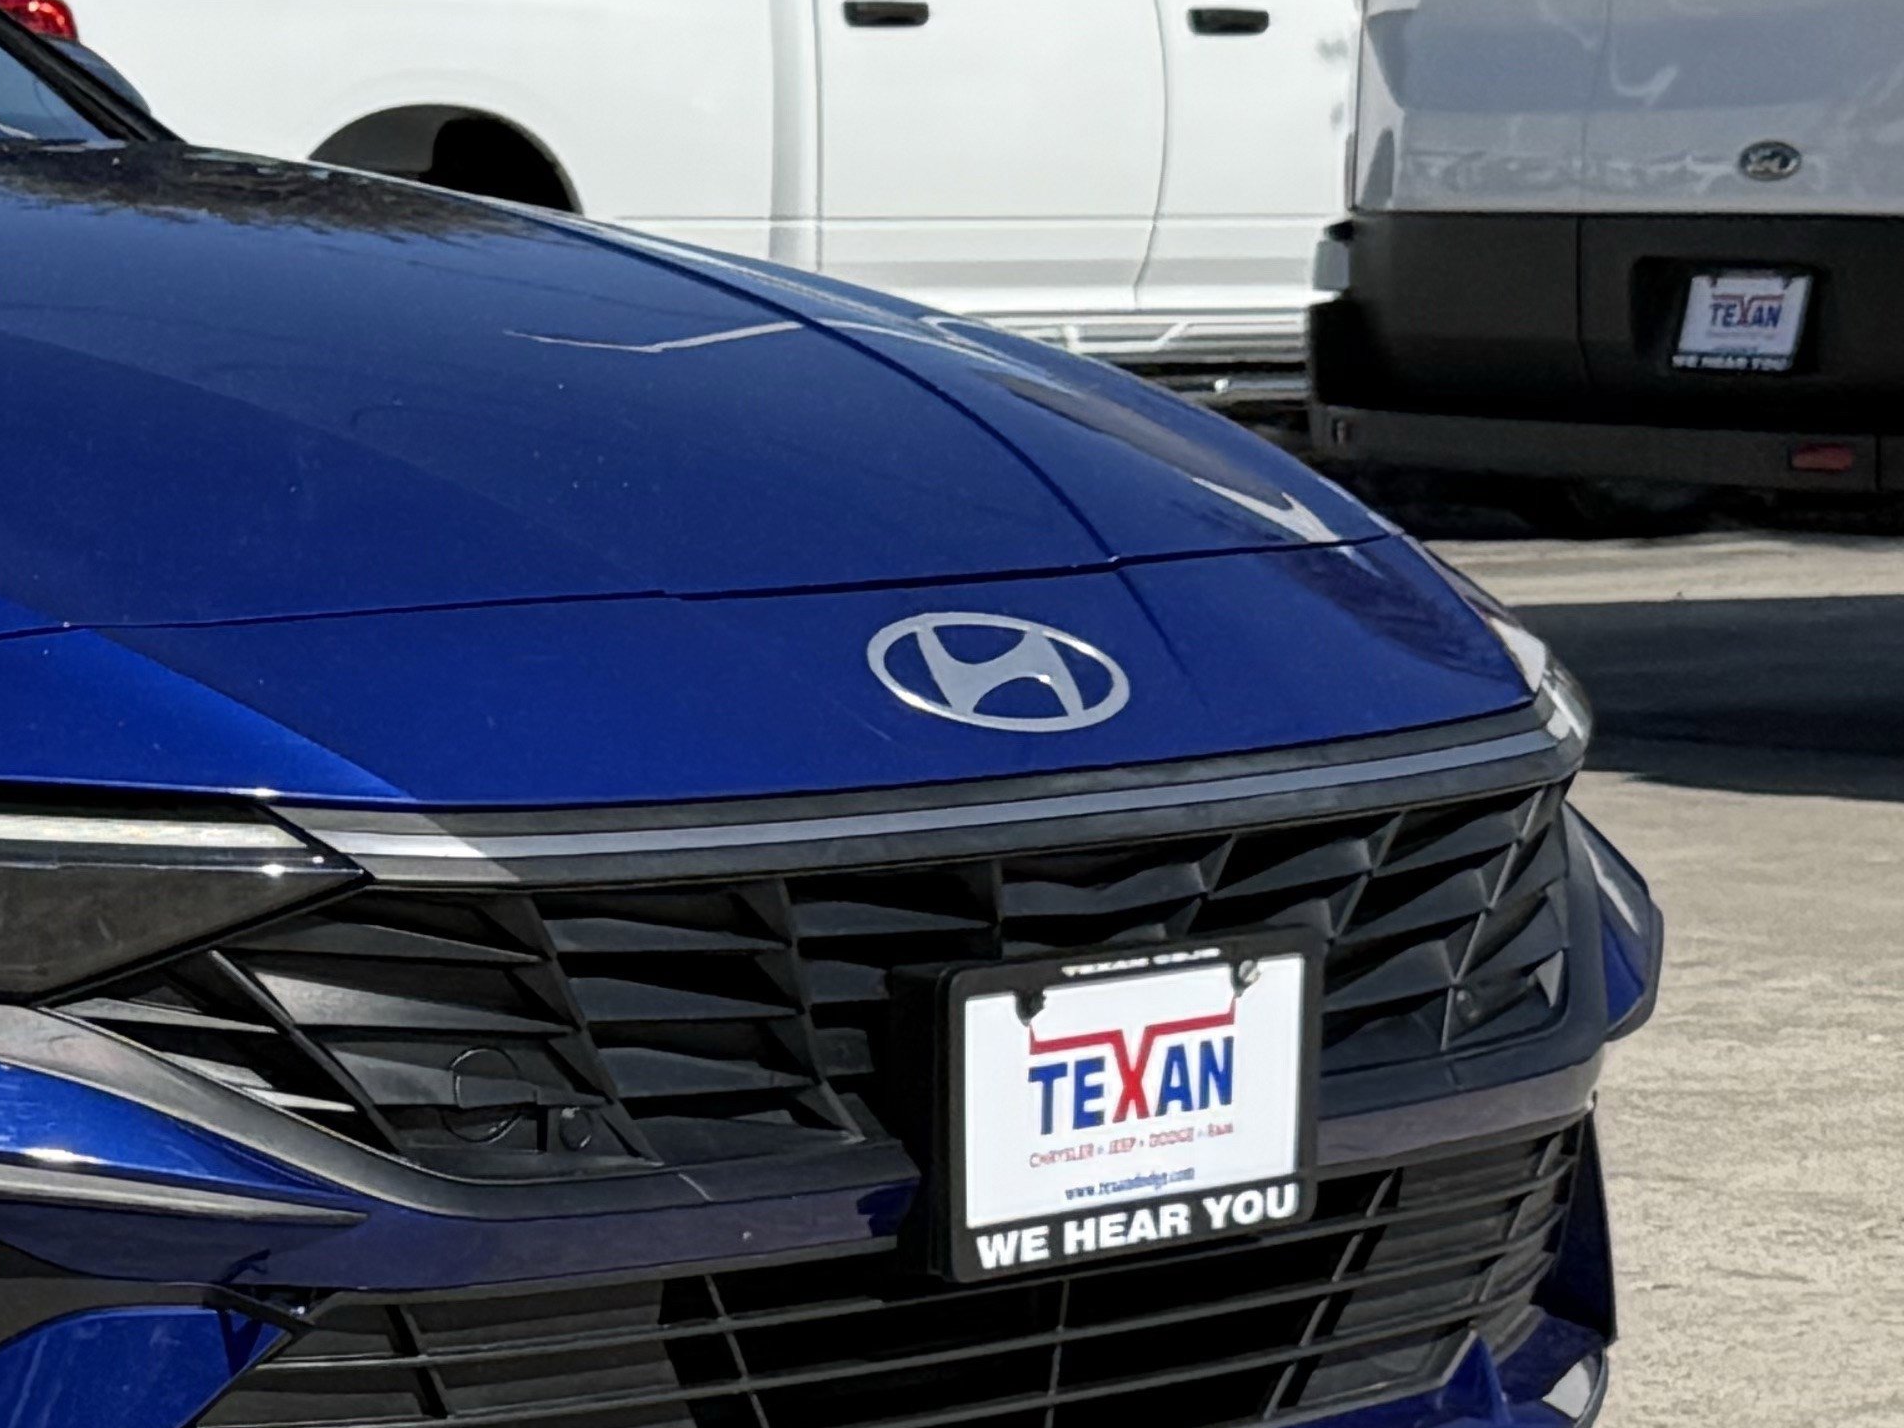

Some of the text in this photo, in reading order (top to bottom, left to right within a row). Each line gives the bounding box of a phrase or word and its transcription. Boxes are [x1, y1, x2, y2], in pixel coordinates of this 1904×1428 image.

[1710, 295, 1783, 327] TEXAN
[1028, 1016, 1235, 1135] TEXAN
[976, 1183, 1299, 1269] WE HEAR YOU
